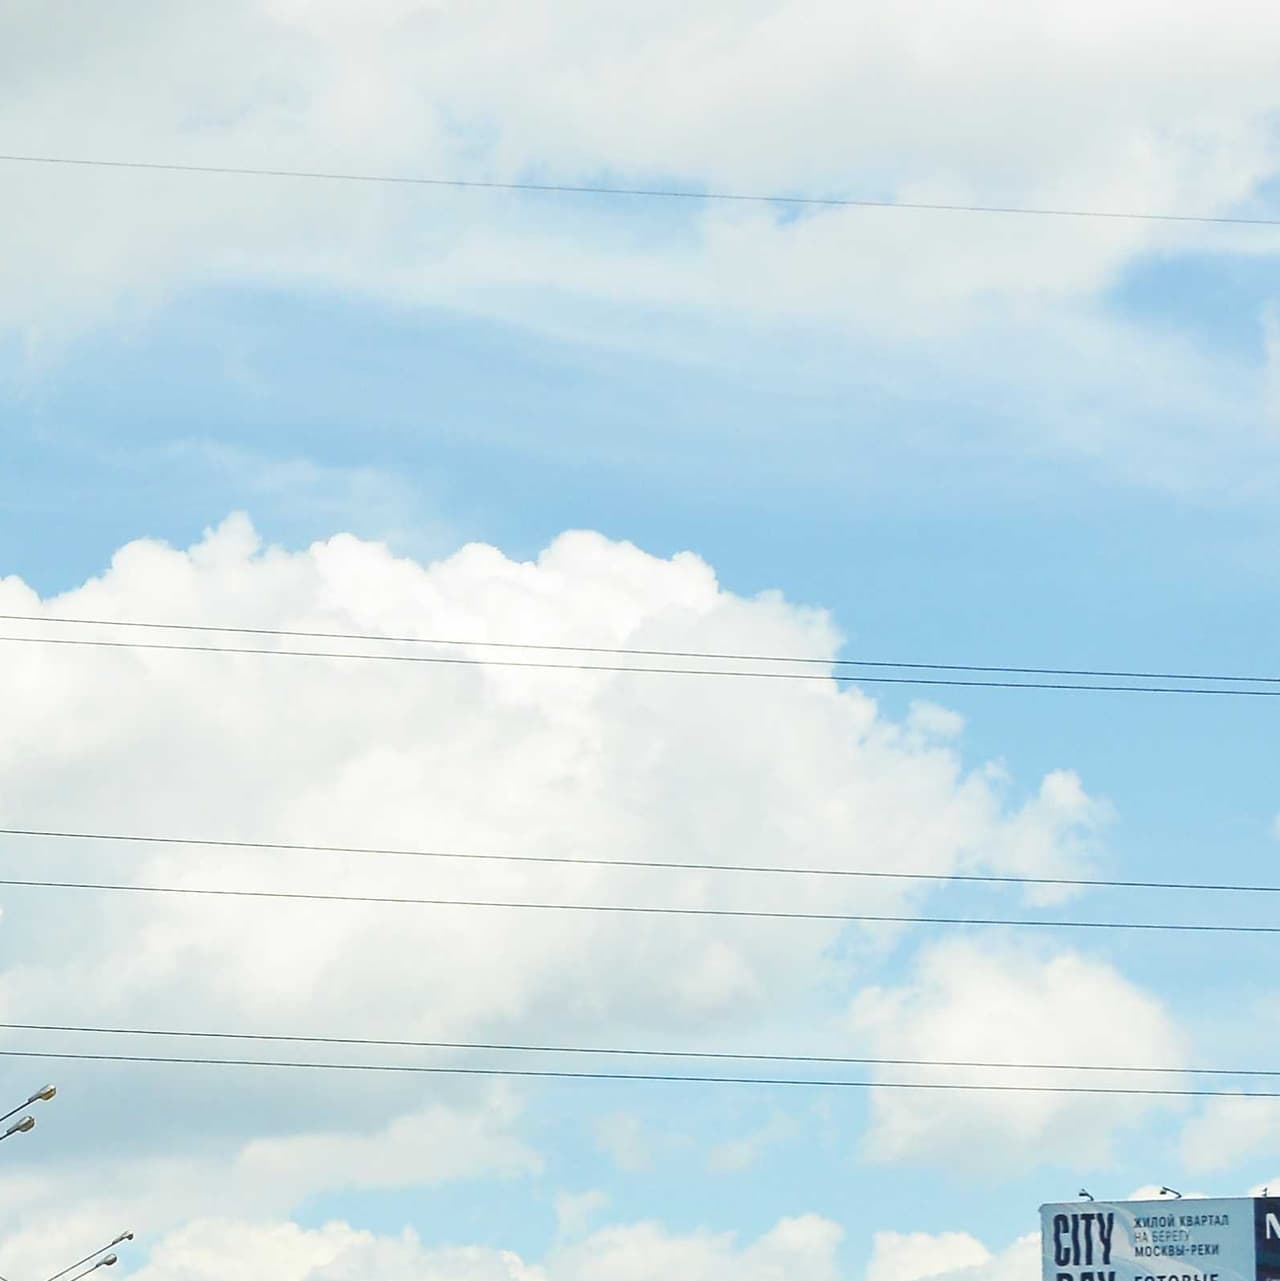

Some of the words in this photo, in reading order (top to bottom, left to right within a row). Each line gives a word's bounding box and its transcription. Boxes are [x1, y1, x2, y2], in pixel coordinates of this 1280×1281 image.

[1134, 1213, 1175, 1229] ЖИЛОЙ
[1179, 1214, 1229, 1227] КВАРТАЛ
[1053, 1213, 1114, 1266] CITY
[1135, 1231, 1148, 1242] НА
[1152, 1229, 1191, 1242] БЕРЕГУ
[1135, 1244, 1220, 1257] МОСКВЫ-РЕКИ
